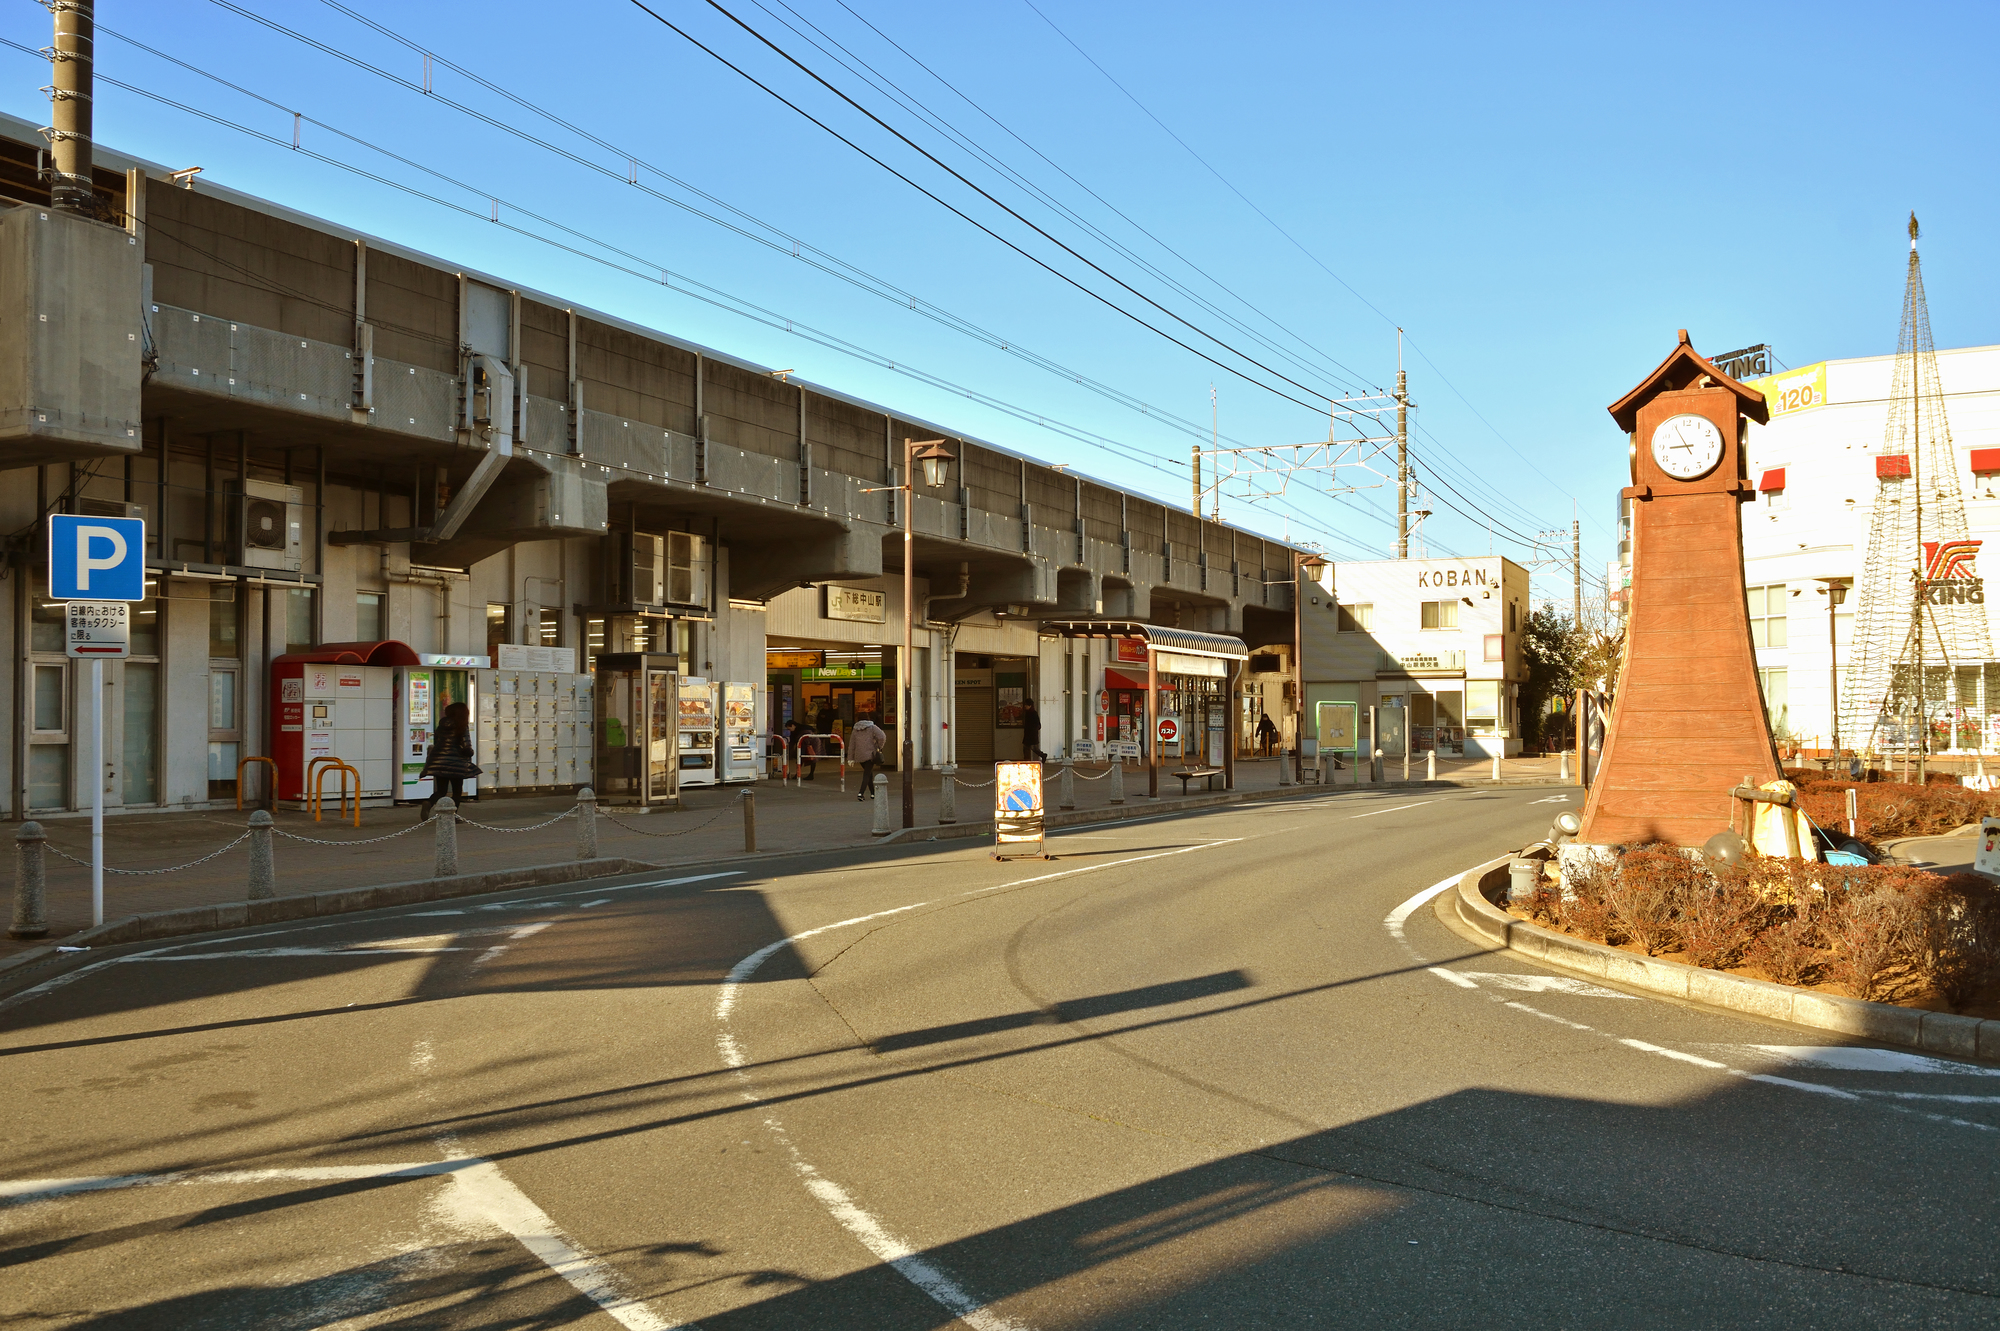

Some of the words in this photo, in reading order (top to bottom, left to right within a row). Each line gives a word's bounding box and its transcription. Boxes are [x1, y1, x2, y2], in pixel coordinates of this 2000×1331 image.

[1780, 386, 1812, 411] 120
[77, 526, 127, 590] P
[1419, 569, 1486, 588] KOBAN
[832, 596, 842, 608] JR
[844, 592, 881, 606] 下総中山駅
[71, 606, 125, 616] 白線内における
[71, 618, 125, 628] 客待ちタクシー
[71, 630, 91, 640] に限る
[818, 667, 856, 676] NewDays
